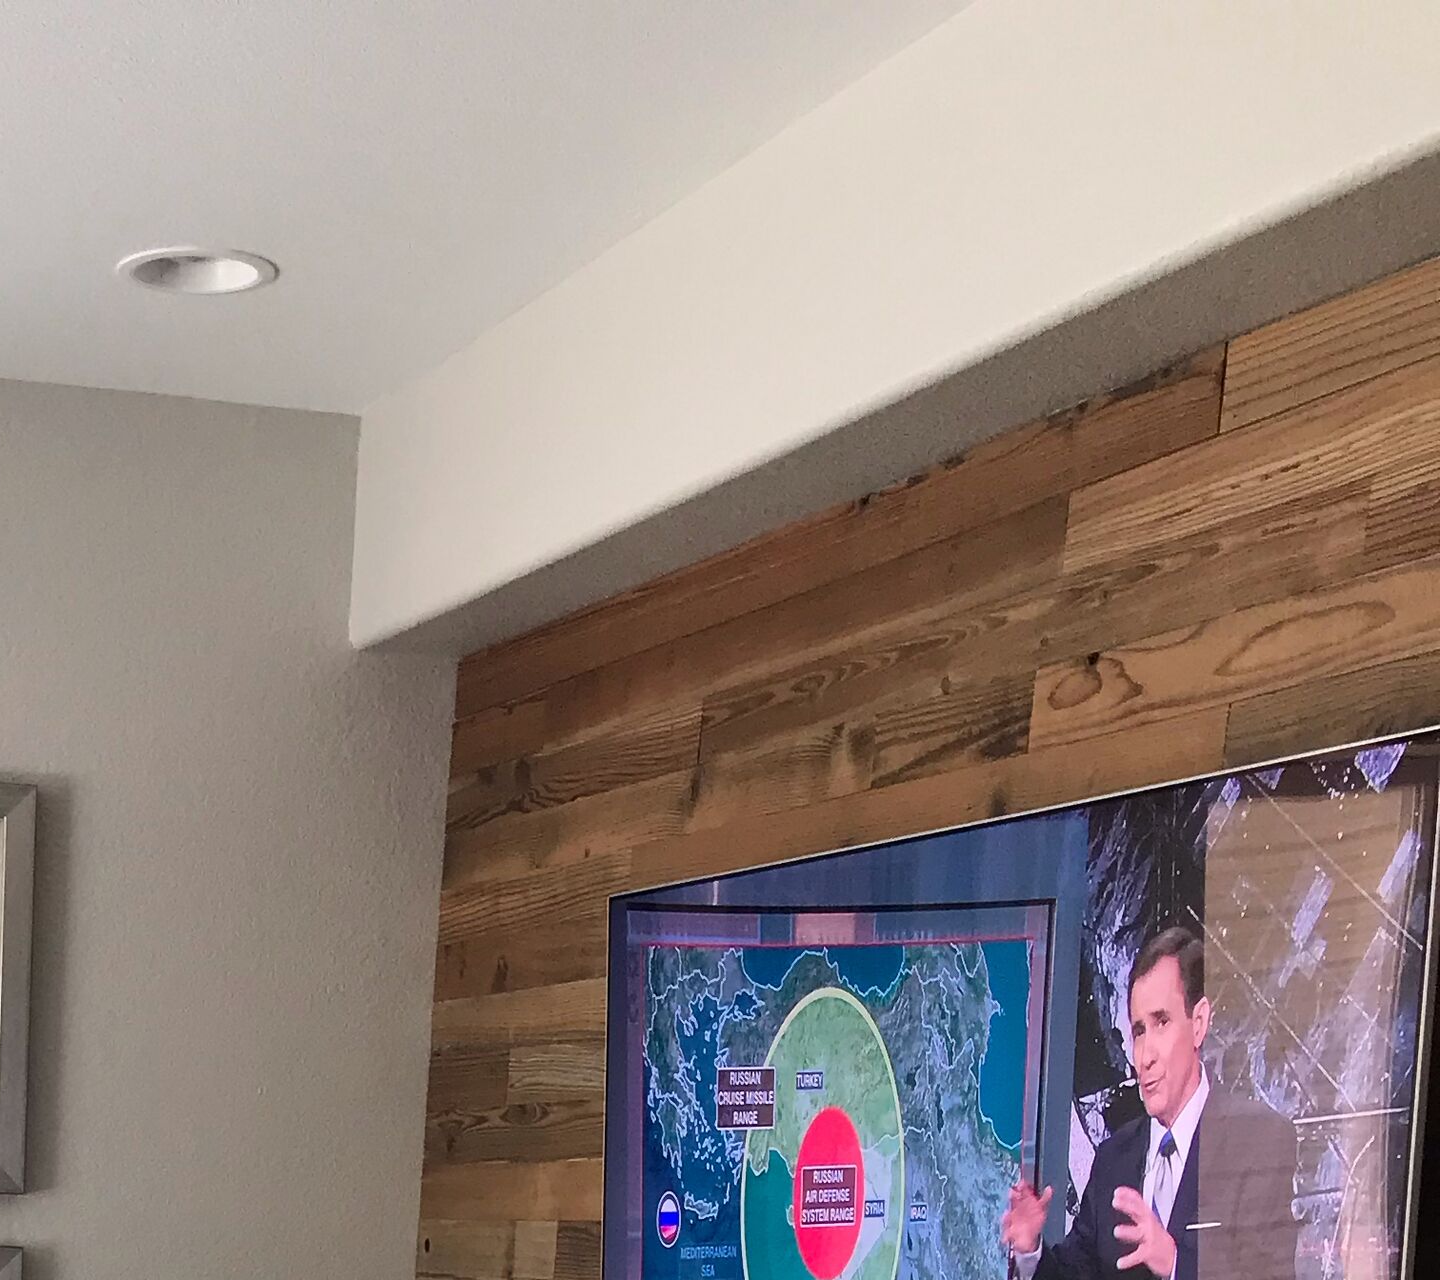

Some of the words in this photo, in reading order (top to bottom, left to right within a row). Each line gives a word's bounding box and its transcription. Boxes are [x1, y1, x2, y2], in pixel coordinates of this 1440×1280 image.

[729, 1071, 762, 1086] RUSSIAN
[796, 1073, 824, 1088] TURKEY
[718, 1091, 745, 1105] CRUISE
[746, 1091, 774, 1104] MISSILE
[733, 1111, 758, 1125] RANGE
[813, 1170, 843, 1183] RUSSIAN
[805, 1190, 818, 1203] AIR
[819, 1189, 850, 1202] DEFENSE
[801, 1209, 829, 1223] SYSTEM
[830, 1207, 854, 1221] RANGE
[865, 1201, 885, 1216] SYRIA
[910, 1205, 927, 1220] IRAQ
[680, 1246, 737, 1260] MEDITERRANEAN
[701, 1265, 715, 1277] SEA
